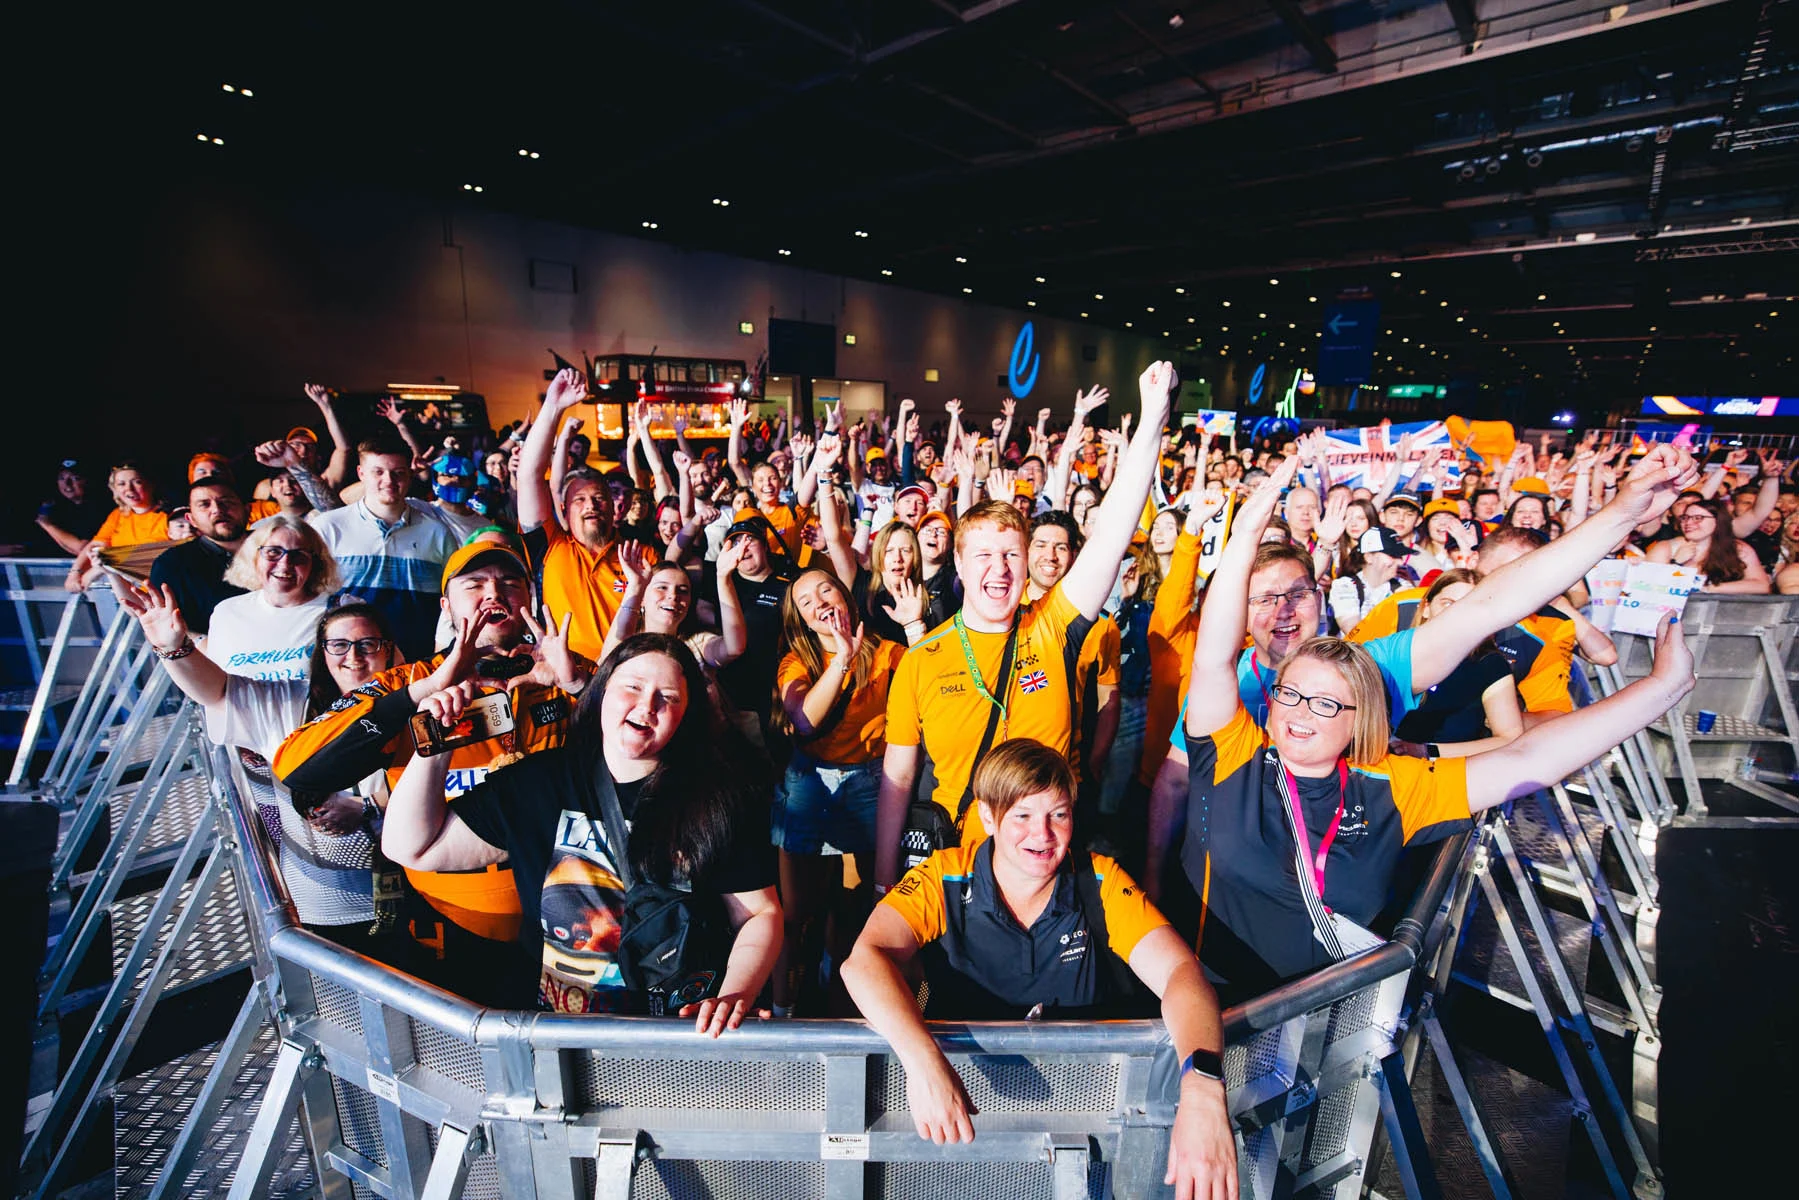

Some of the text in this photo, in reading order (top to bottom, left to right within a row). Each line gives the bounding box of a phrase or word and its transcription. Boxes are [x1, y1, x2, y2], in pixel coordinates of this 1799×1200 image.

[226, 645, 306, 669] FORMULA
[940, 683, 966, 695] DELL
[489, 702, 502, 727] 10:59
